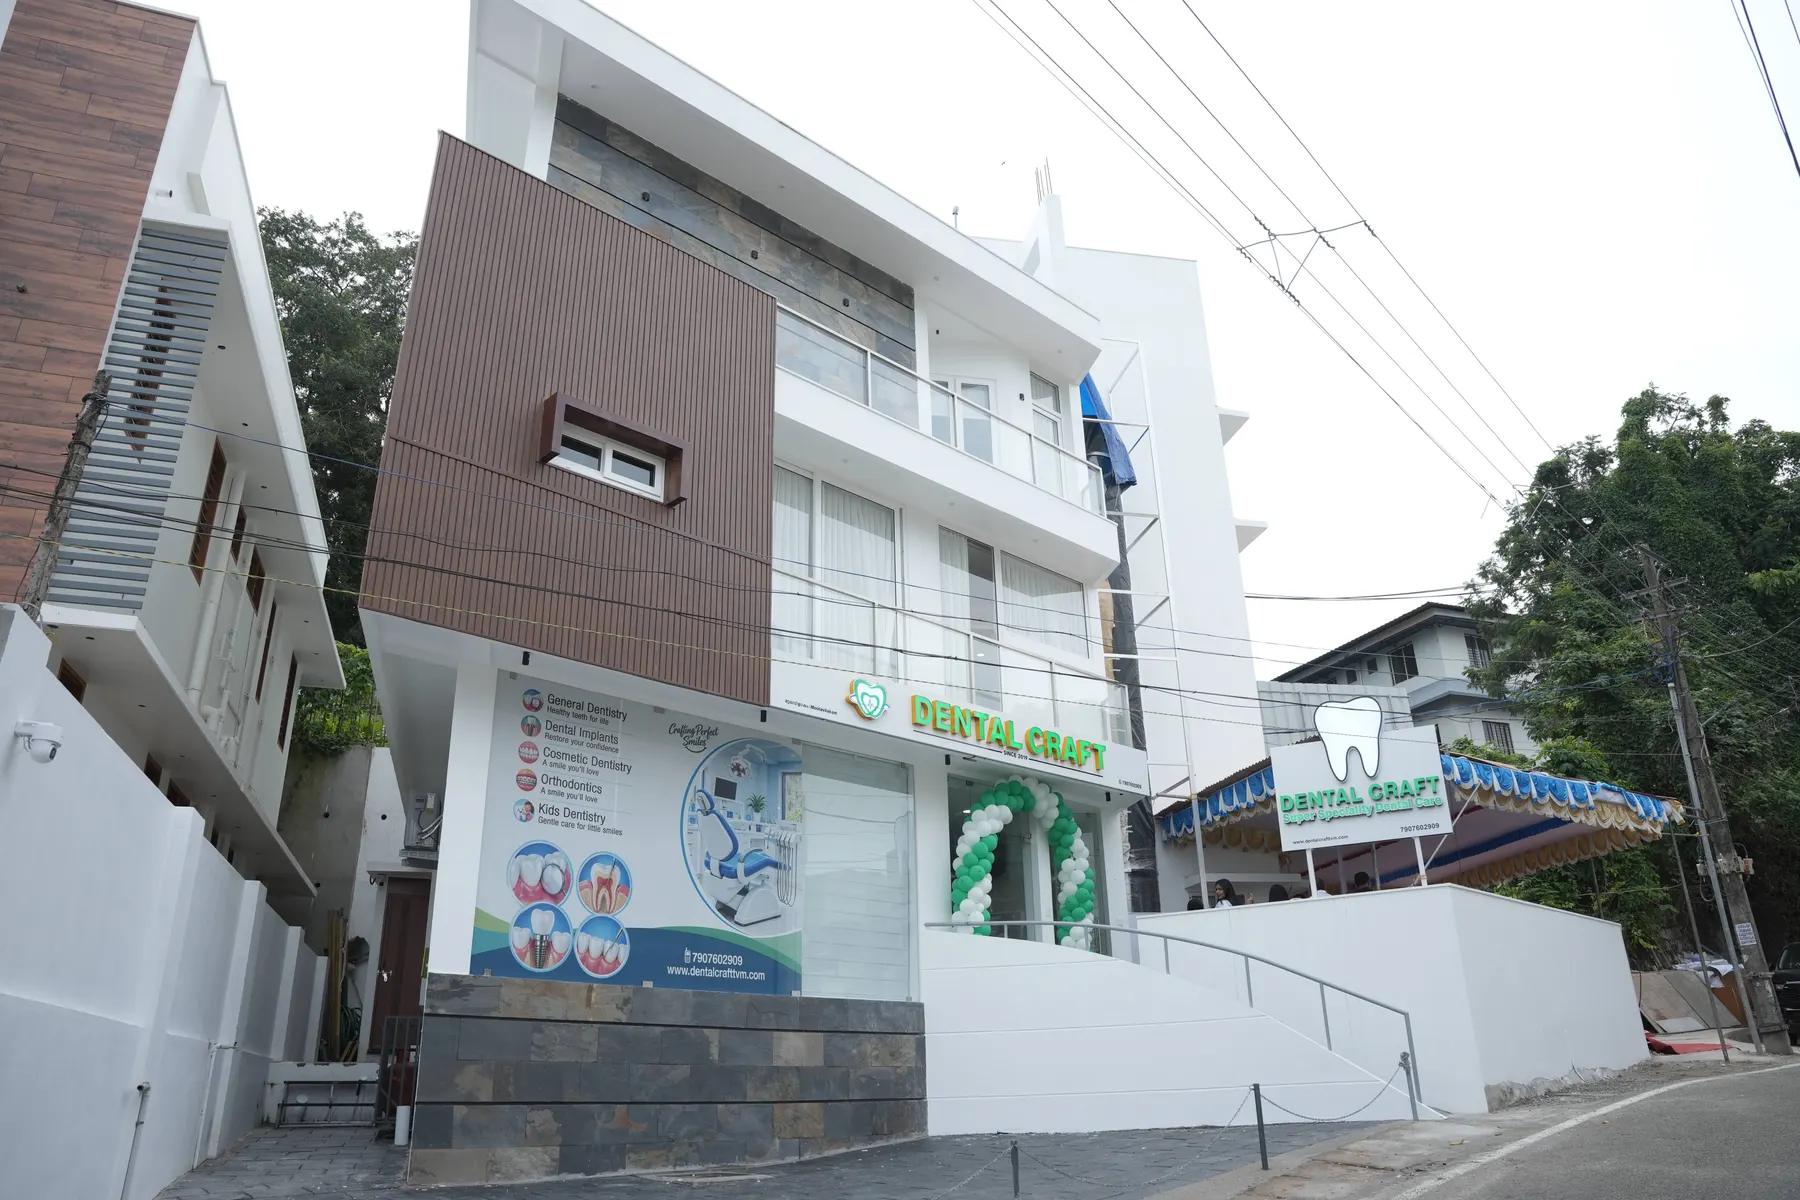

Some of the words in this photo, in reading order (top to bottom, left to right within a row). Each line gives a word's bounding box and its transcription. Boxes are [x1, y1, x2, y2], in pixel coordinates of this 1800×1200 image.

[547, 706, 570, 718] Healthy
[572, 712, 587, 720] teeth
[590, 714, 598, 722] for
[548, 694, 584, 710] General
[588, 703, 627, 722] Dentistry
[546, 720, 576, 735] Dental
[580, 727, 619, 744] Implants
[669, 723, 695, 738] Crafting
[695, 724, 719, 739] Perfect
[683, 735, 706, 746] Smiles
[911, 695, 1023, 750] DENTAL
[1025, 727, 1106, 771] CRAFT
[545, 733, 568, 743] Restore
[570, 738, 584, 746] your
[586, 741, 619, 753] confidence
[544, 747, 588, 764] Cosmetic
[592, 756, 632, 774] Dentistry
[1003, 750, 1017, 759] SINCE
[549, 761, 566, 769] smile
[568, 765, 585, 773] you'll
[587, 768, 599, 776] love
[541, 774, 602, 794] Orthodontics
[1280, 787, 1363, 812] DENTAL
[1368, 776, 1439, 800] CRAFT
[548, 789, 564, 797] smile
[567, 792, 583, 800] you'll
[585, 794, 598, 803] love
[539, 803, 560, 816] Kids
[564, 807, 606, 825] Dentistry
[1283, 812, 1316, 825] Super
[1318, 805, 1373, 821] Speciality
[1376, 799, 1412, 813] Dental
[1415, 796, 1442, 807] Care
[538, 816, 559, 826] Gentle
[577, 822, 586, 830] for
[588, 824, 600, 832] little
[603, 827, 622, 836] smiles
[1400, 822, 1440, 832] 7907602909
[692, 953, 743, 965] 7907602909
[667, 966, 765, 980] www.dentalcrafttvm.com
